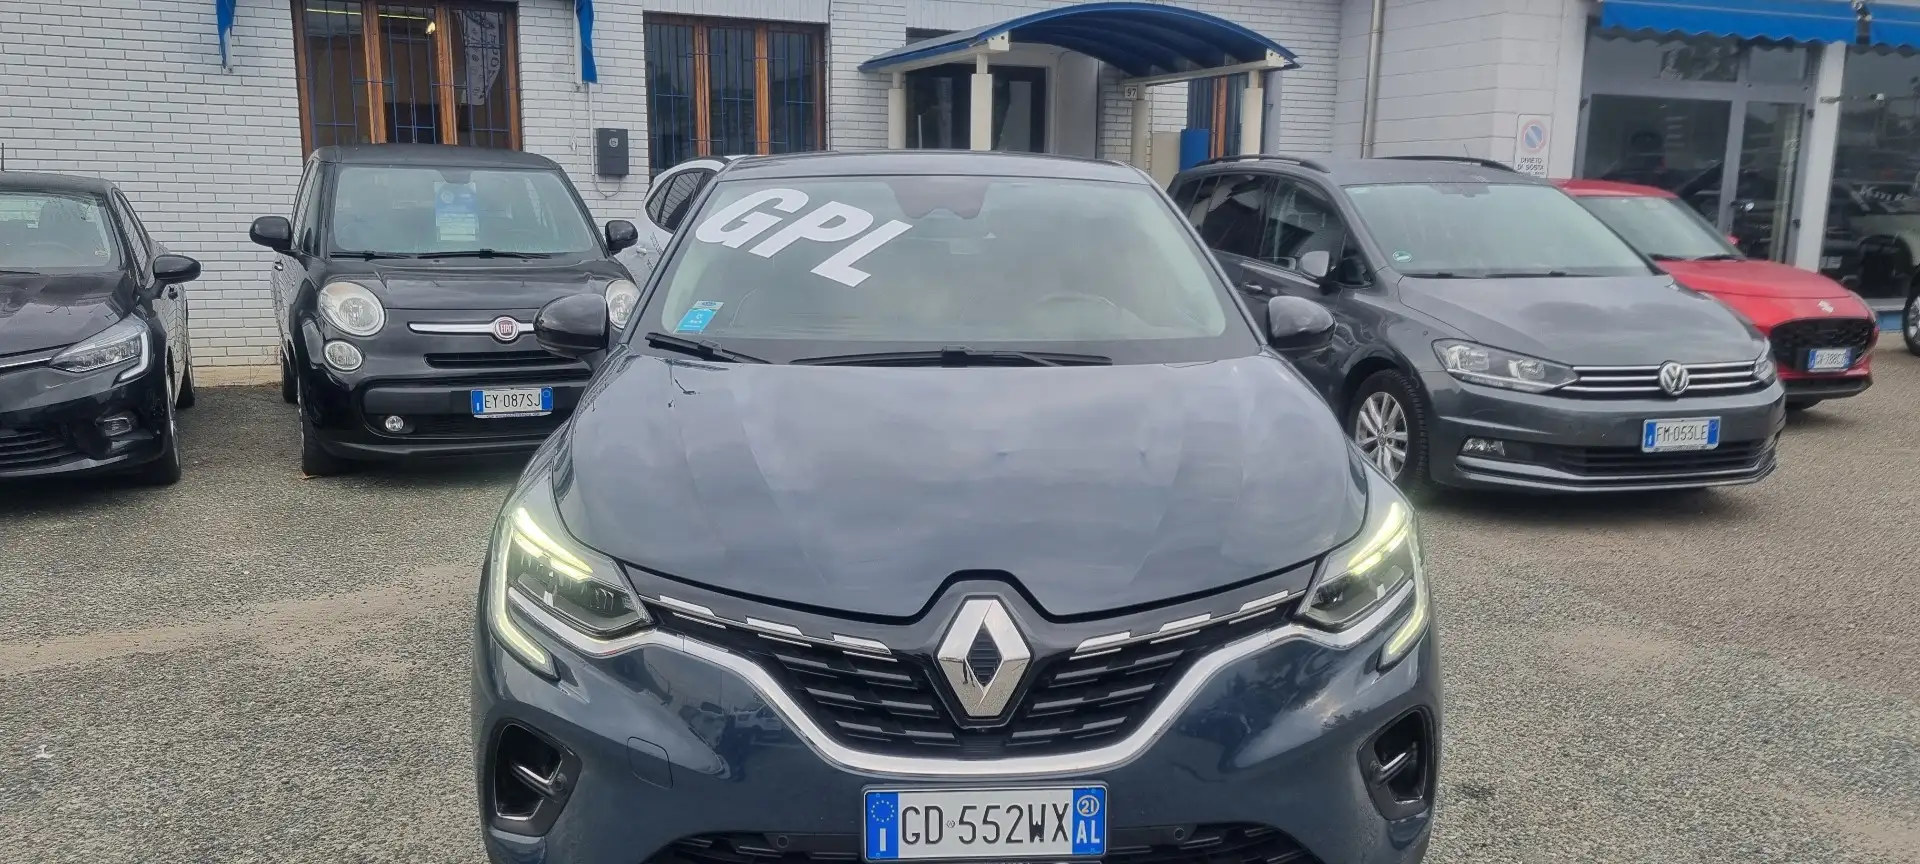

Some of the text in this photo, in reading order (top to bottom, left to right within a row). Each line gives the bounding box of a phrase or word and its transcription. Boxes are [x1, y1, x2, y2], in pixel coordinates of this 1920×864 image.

[695, 188, 913, 288] GPL
[500, 324, 513, 333] FIAT
[1081, 799, 1096, 814] 21
[1075, 820, 1101, 844] AL
